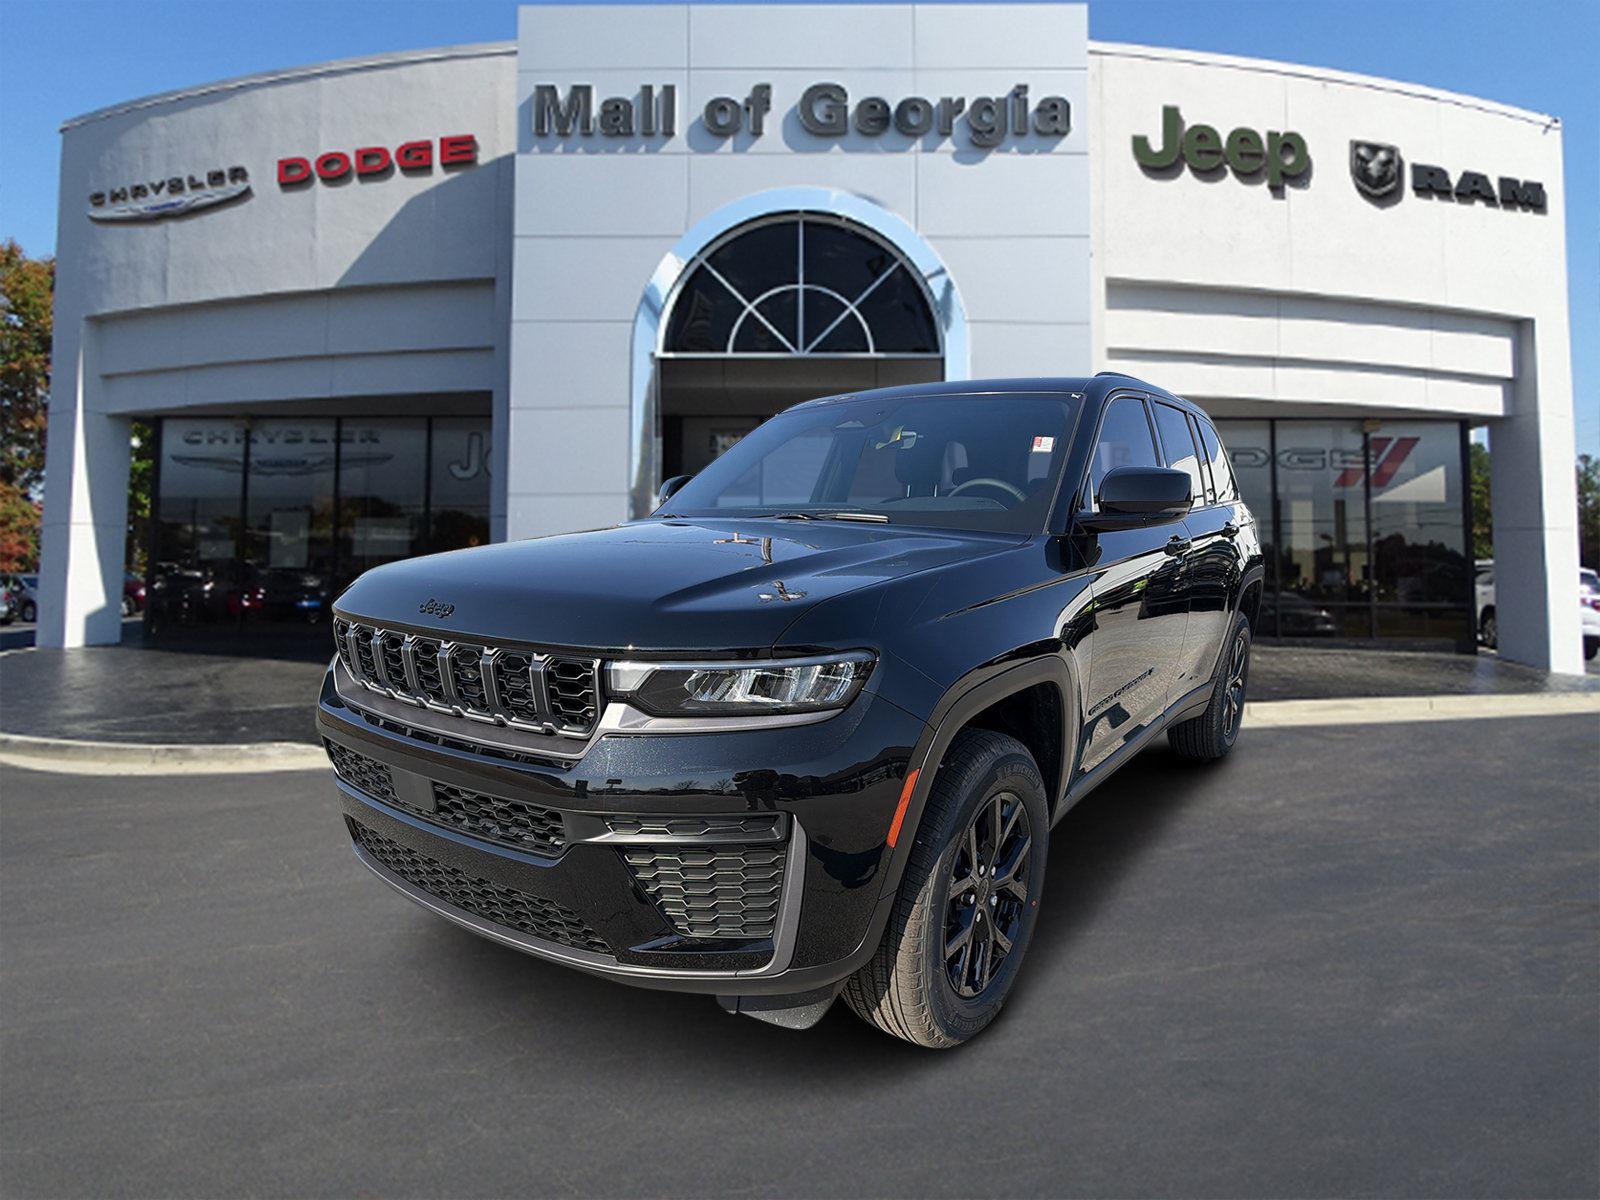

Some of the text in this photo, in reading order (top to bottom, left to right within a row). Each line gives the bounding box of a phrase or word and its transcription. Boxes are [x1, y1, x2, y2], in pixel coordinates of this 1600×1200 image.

[532, 83, 1072, 148] Mall of Georgia
[276, 134, 478, 189] DODGE
[1131, 105, 1311, 195] Jeep
[89, 166, 250, 207] CHRYSLER
[1411, 163, 1547, 215] RAM
[418, 597, 456, 620] Jeep
